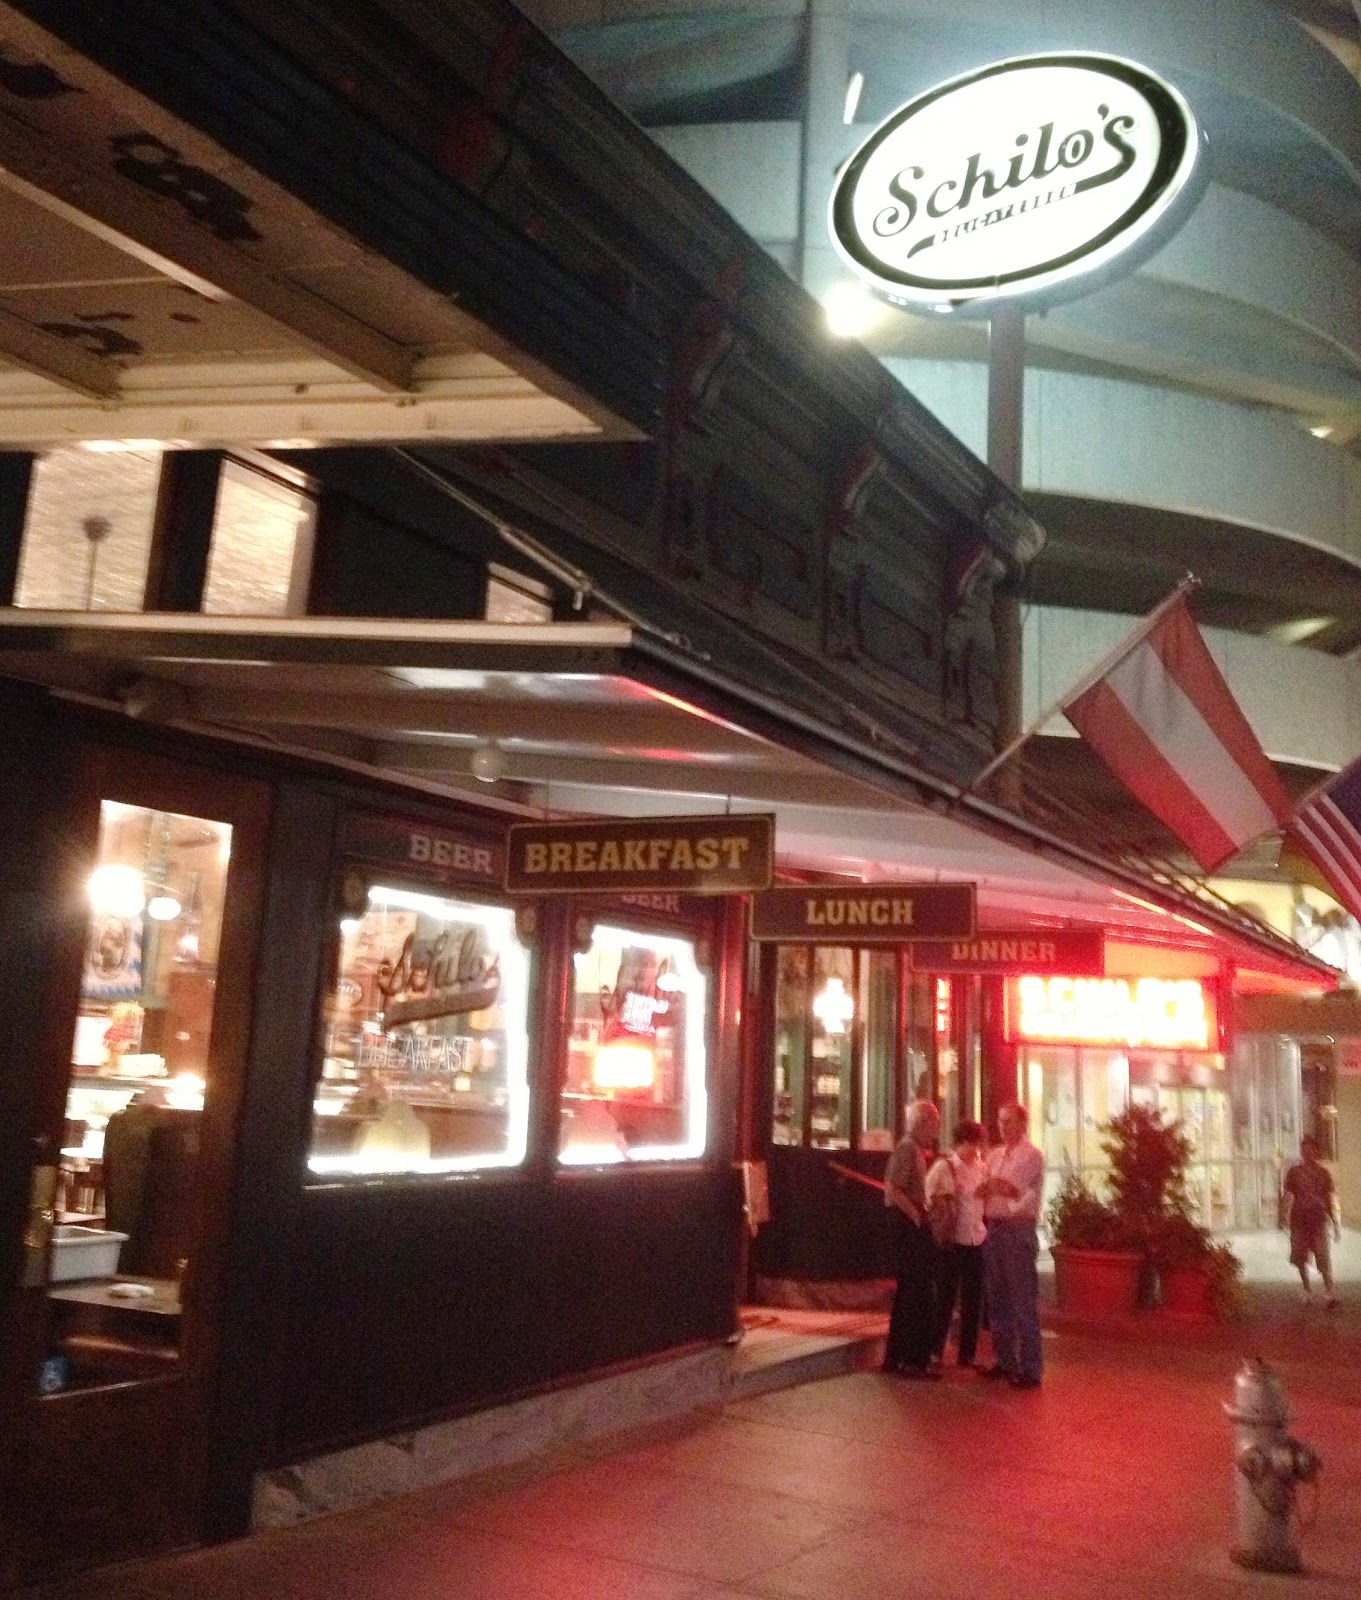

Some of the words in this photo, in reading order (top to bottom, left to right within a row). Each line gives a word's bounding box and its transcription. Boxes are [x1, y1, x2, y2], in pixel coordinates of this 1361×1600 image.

[872, 102, 1137, 238] Schilo's
[409, 834, 493, 874] BEER
[524, 837, 749, 873] BREAKFAST
[806, 899, 915, 926] LUNCH
[951, 939, 1057, 963] DINNER
